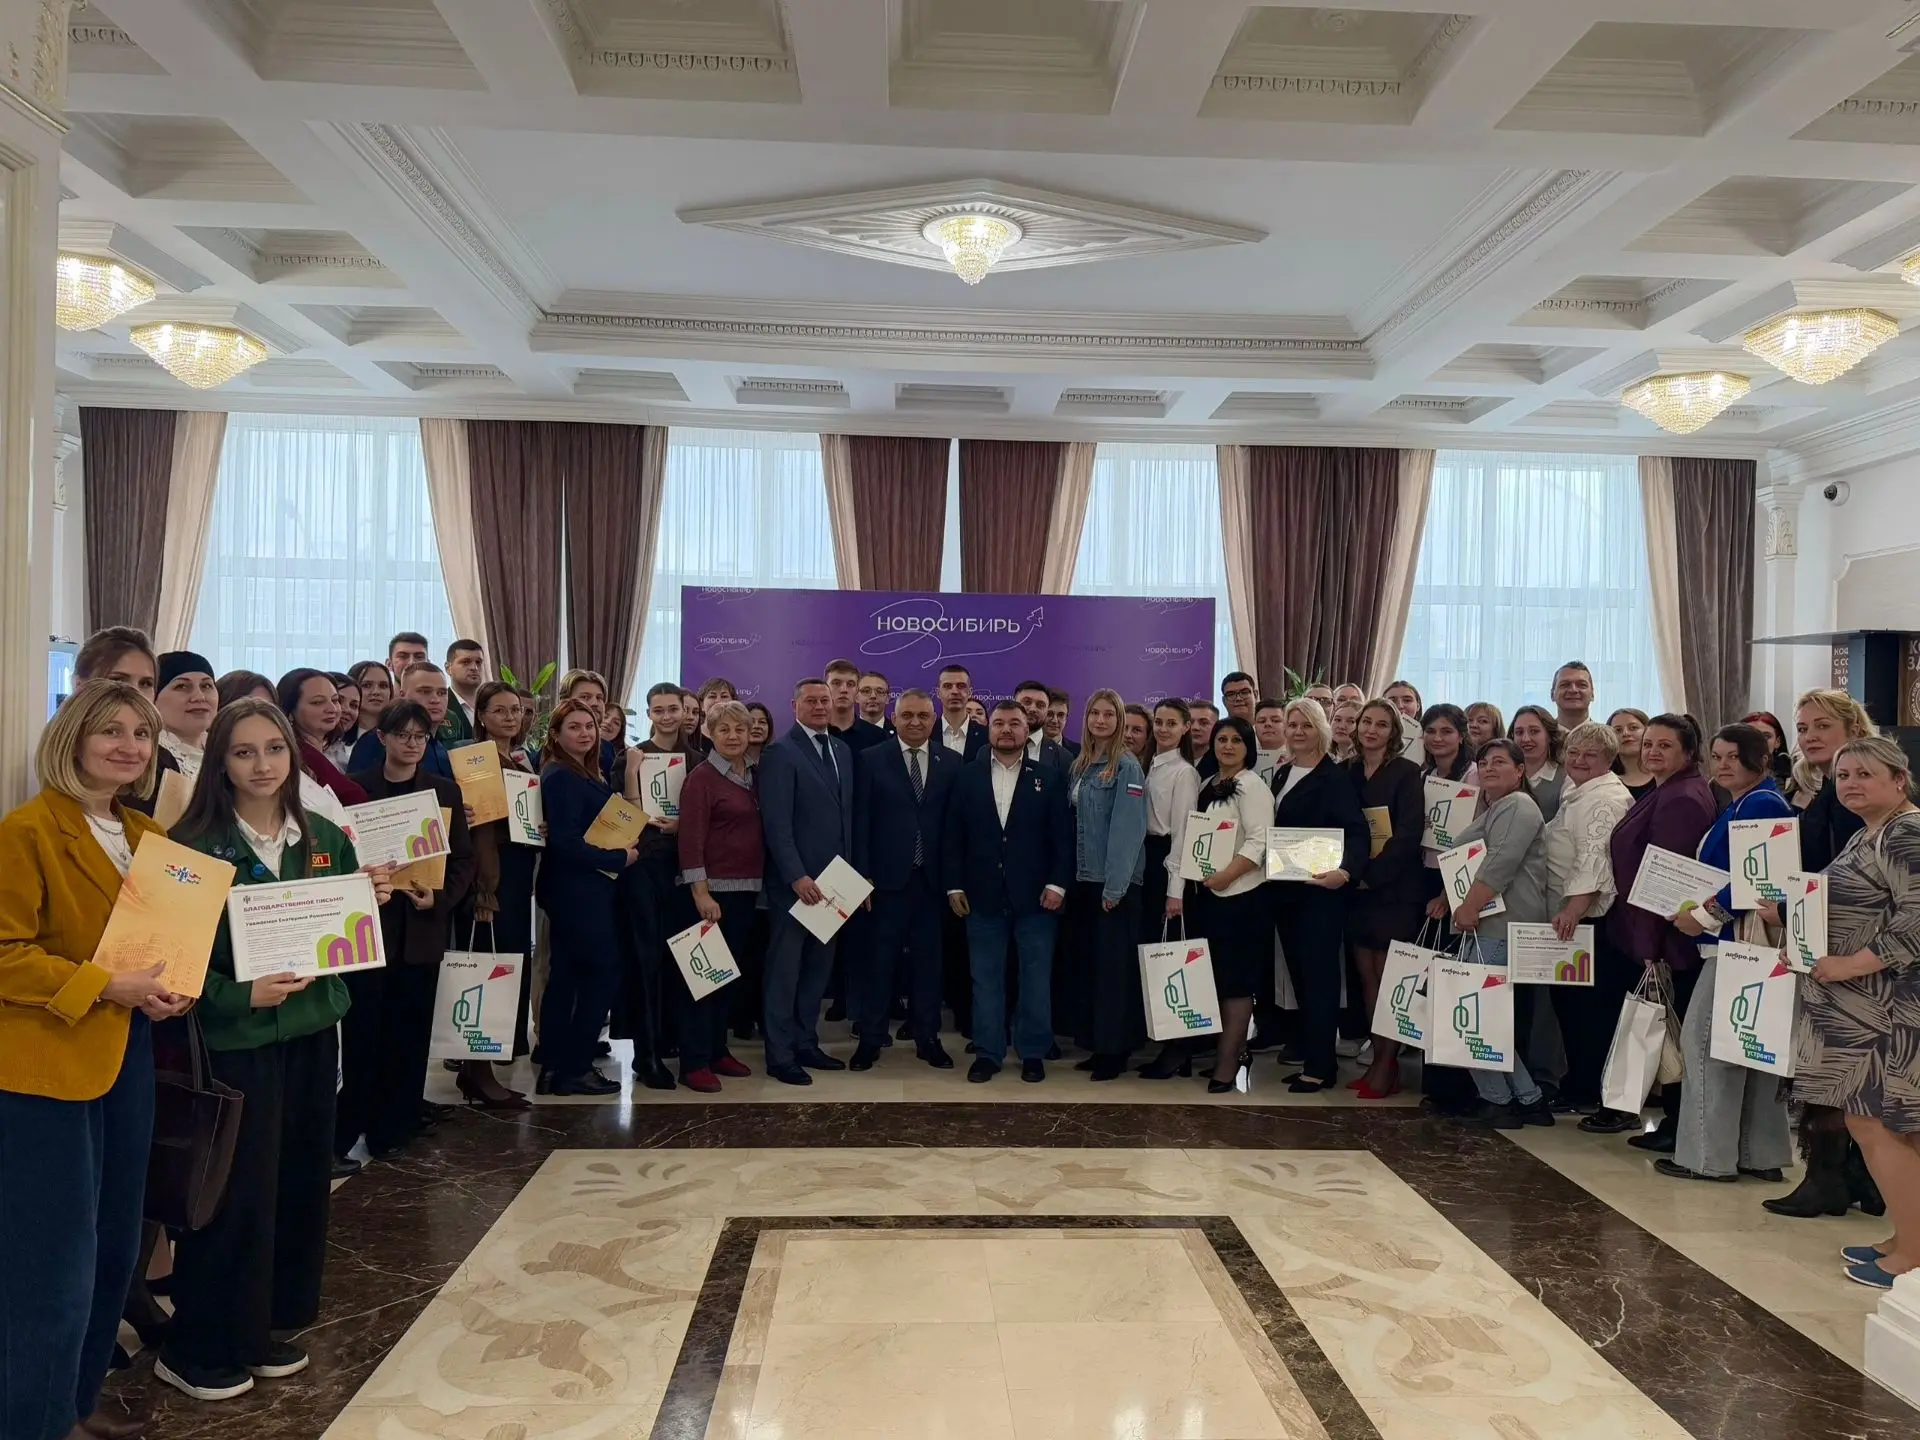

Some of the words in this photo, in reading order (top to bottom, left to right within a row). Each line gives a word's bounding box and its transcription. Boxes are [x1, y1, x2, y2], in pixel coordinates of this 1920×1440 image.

[877, 616, 1020, 633] НОВОСИБИРЬ
[243, 899, 315, 912] БЛАГОДАРСТВЕННОЕ
[315, 896, 344, 905] ПИСЬМО
[1725, 951, 1760, 962] добро.рф
[1466, 1037, 1481, 1045] Могу
[1740, 1032, 1755, 1042] Могу
[1474, 1052, 1503, 1061] устроить
[1747, 1050, 1775, 1062] устроить
